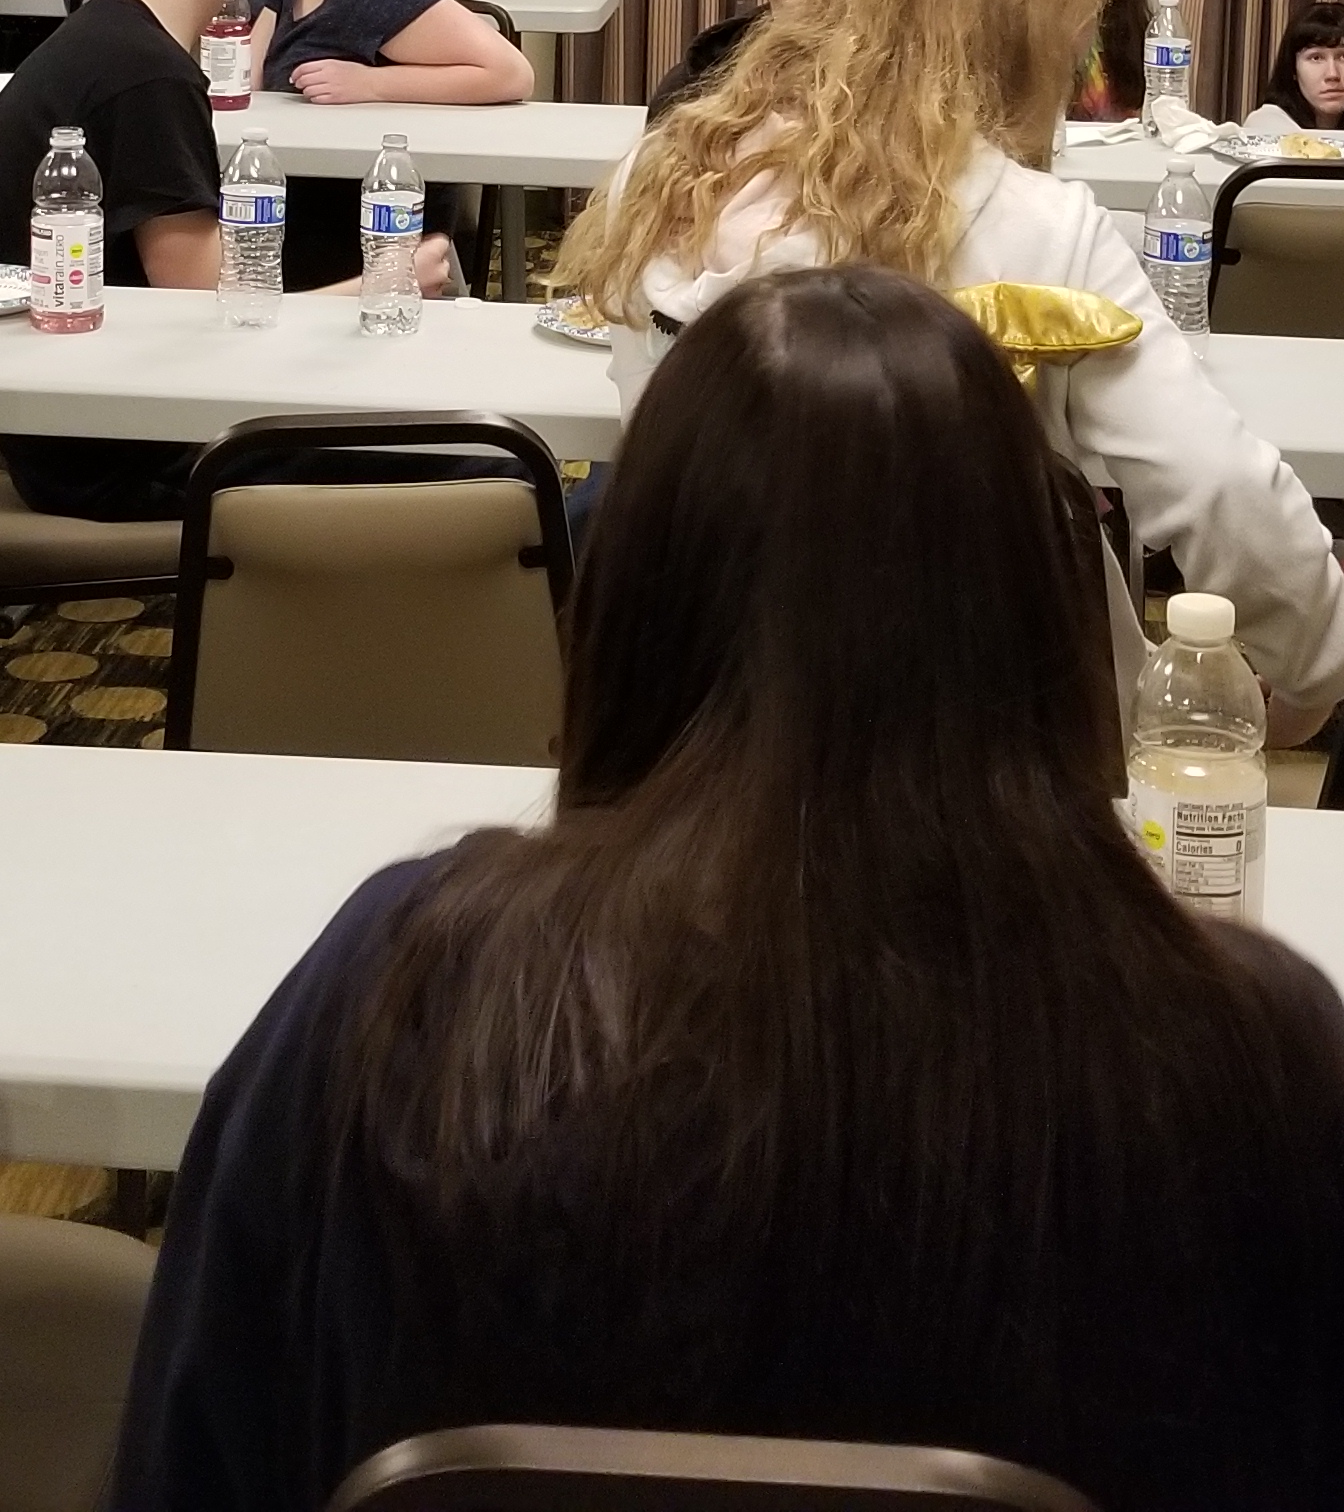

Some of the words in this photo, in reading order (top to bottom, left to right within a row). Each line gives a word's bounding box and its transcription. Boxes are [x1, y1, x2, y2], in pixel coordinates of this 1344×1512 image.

[1177, 811, 1218, 823] Nutrition
[1222, 812, 1245, 823] Facts
[1176, 841, 1213, 854] Calories
